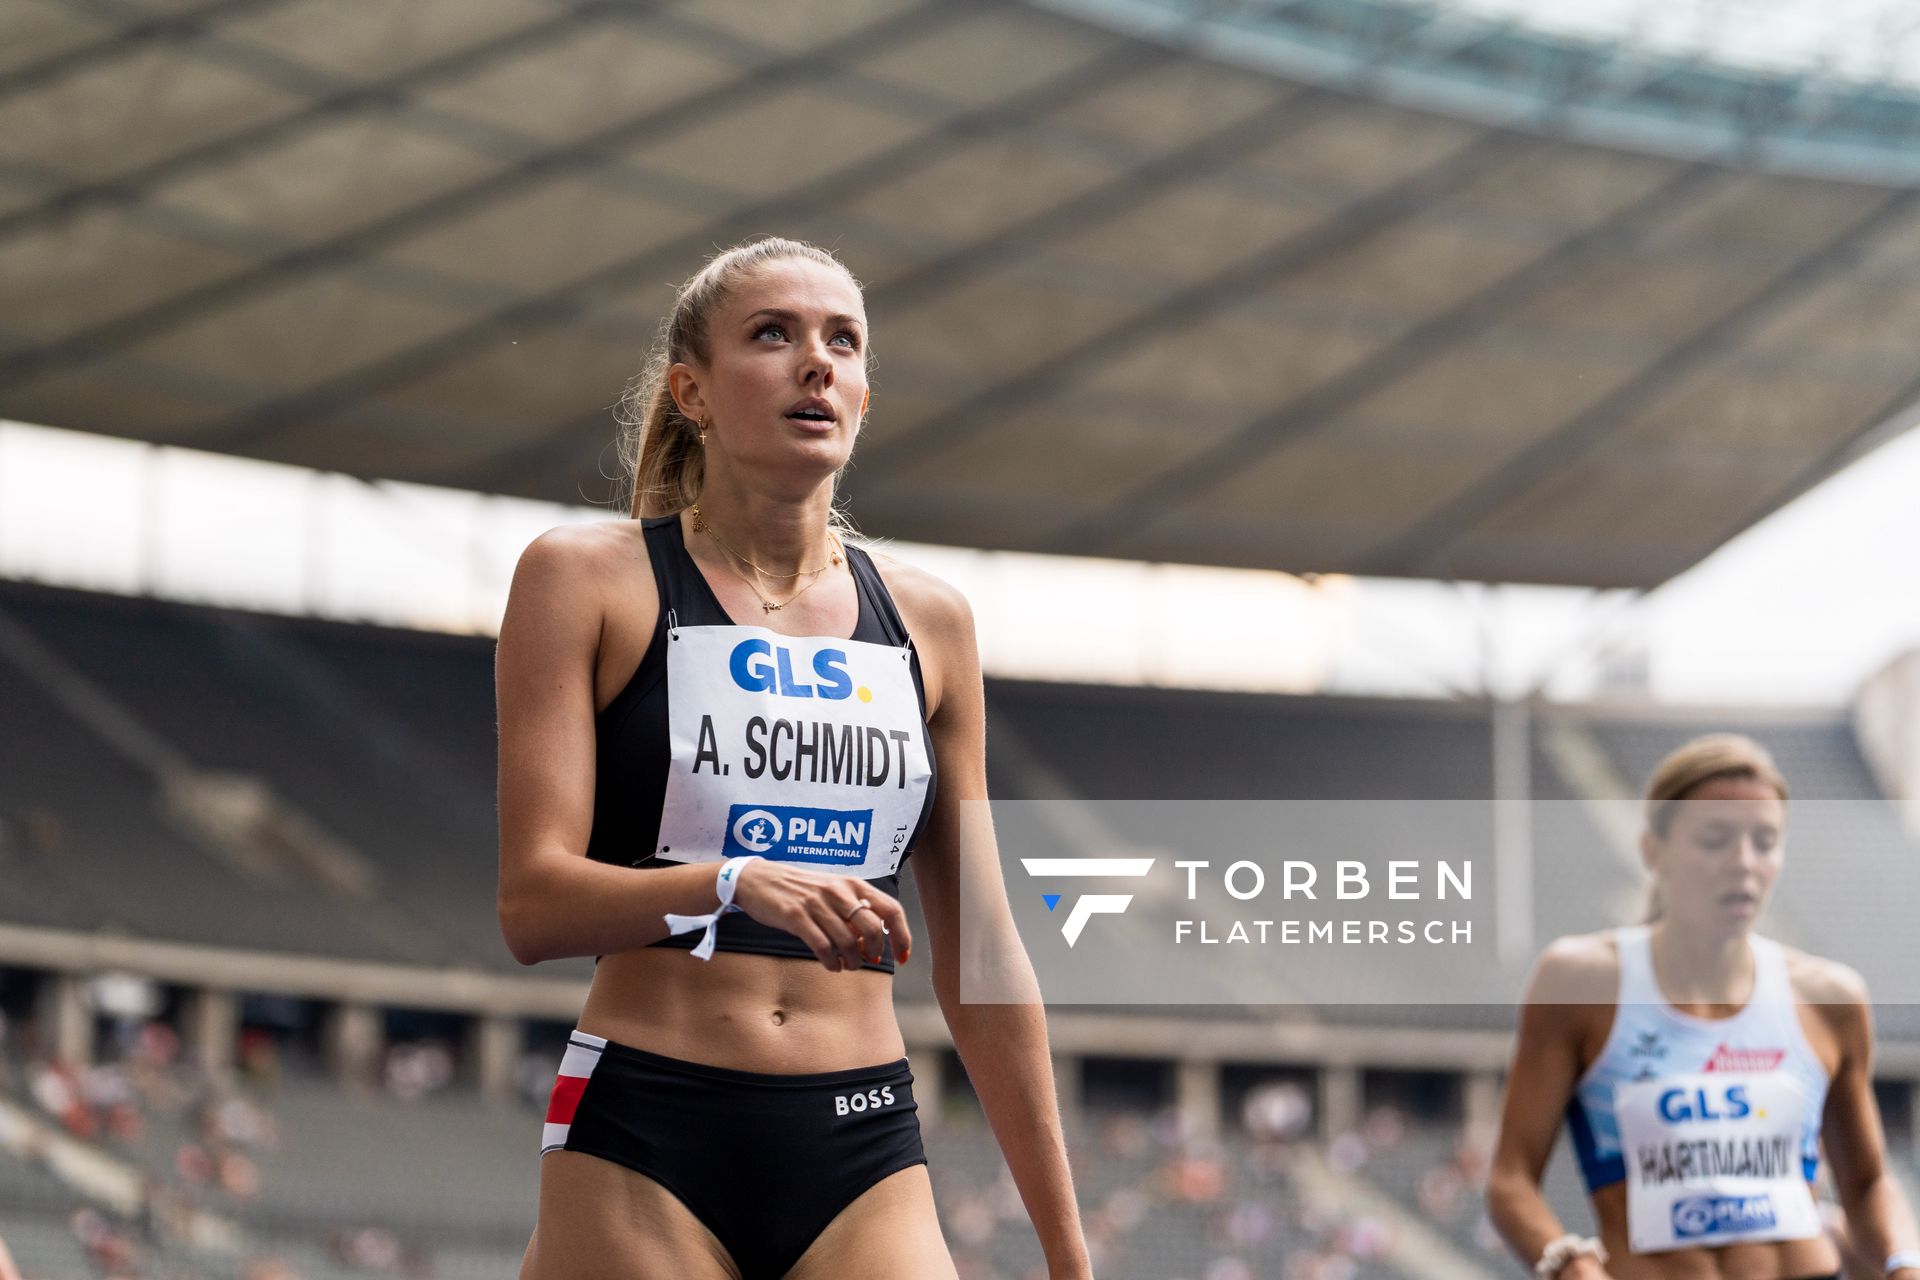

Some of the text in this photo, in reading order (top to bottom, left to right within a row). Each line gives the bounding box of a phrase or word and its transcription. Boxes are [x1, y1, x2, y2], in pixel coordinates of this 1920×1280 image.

[692, 715, 910, 789] A. SCHMIDT
[788, 817, 865, 846] PLAN
[890, 824, 907, 855] 134
[787, 845, 861, 858] INTERNATIONAL
[835, 1085, 895, 1116] BOSS
[1638, 1135, 1790, 1188] HARTMANN
